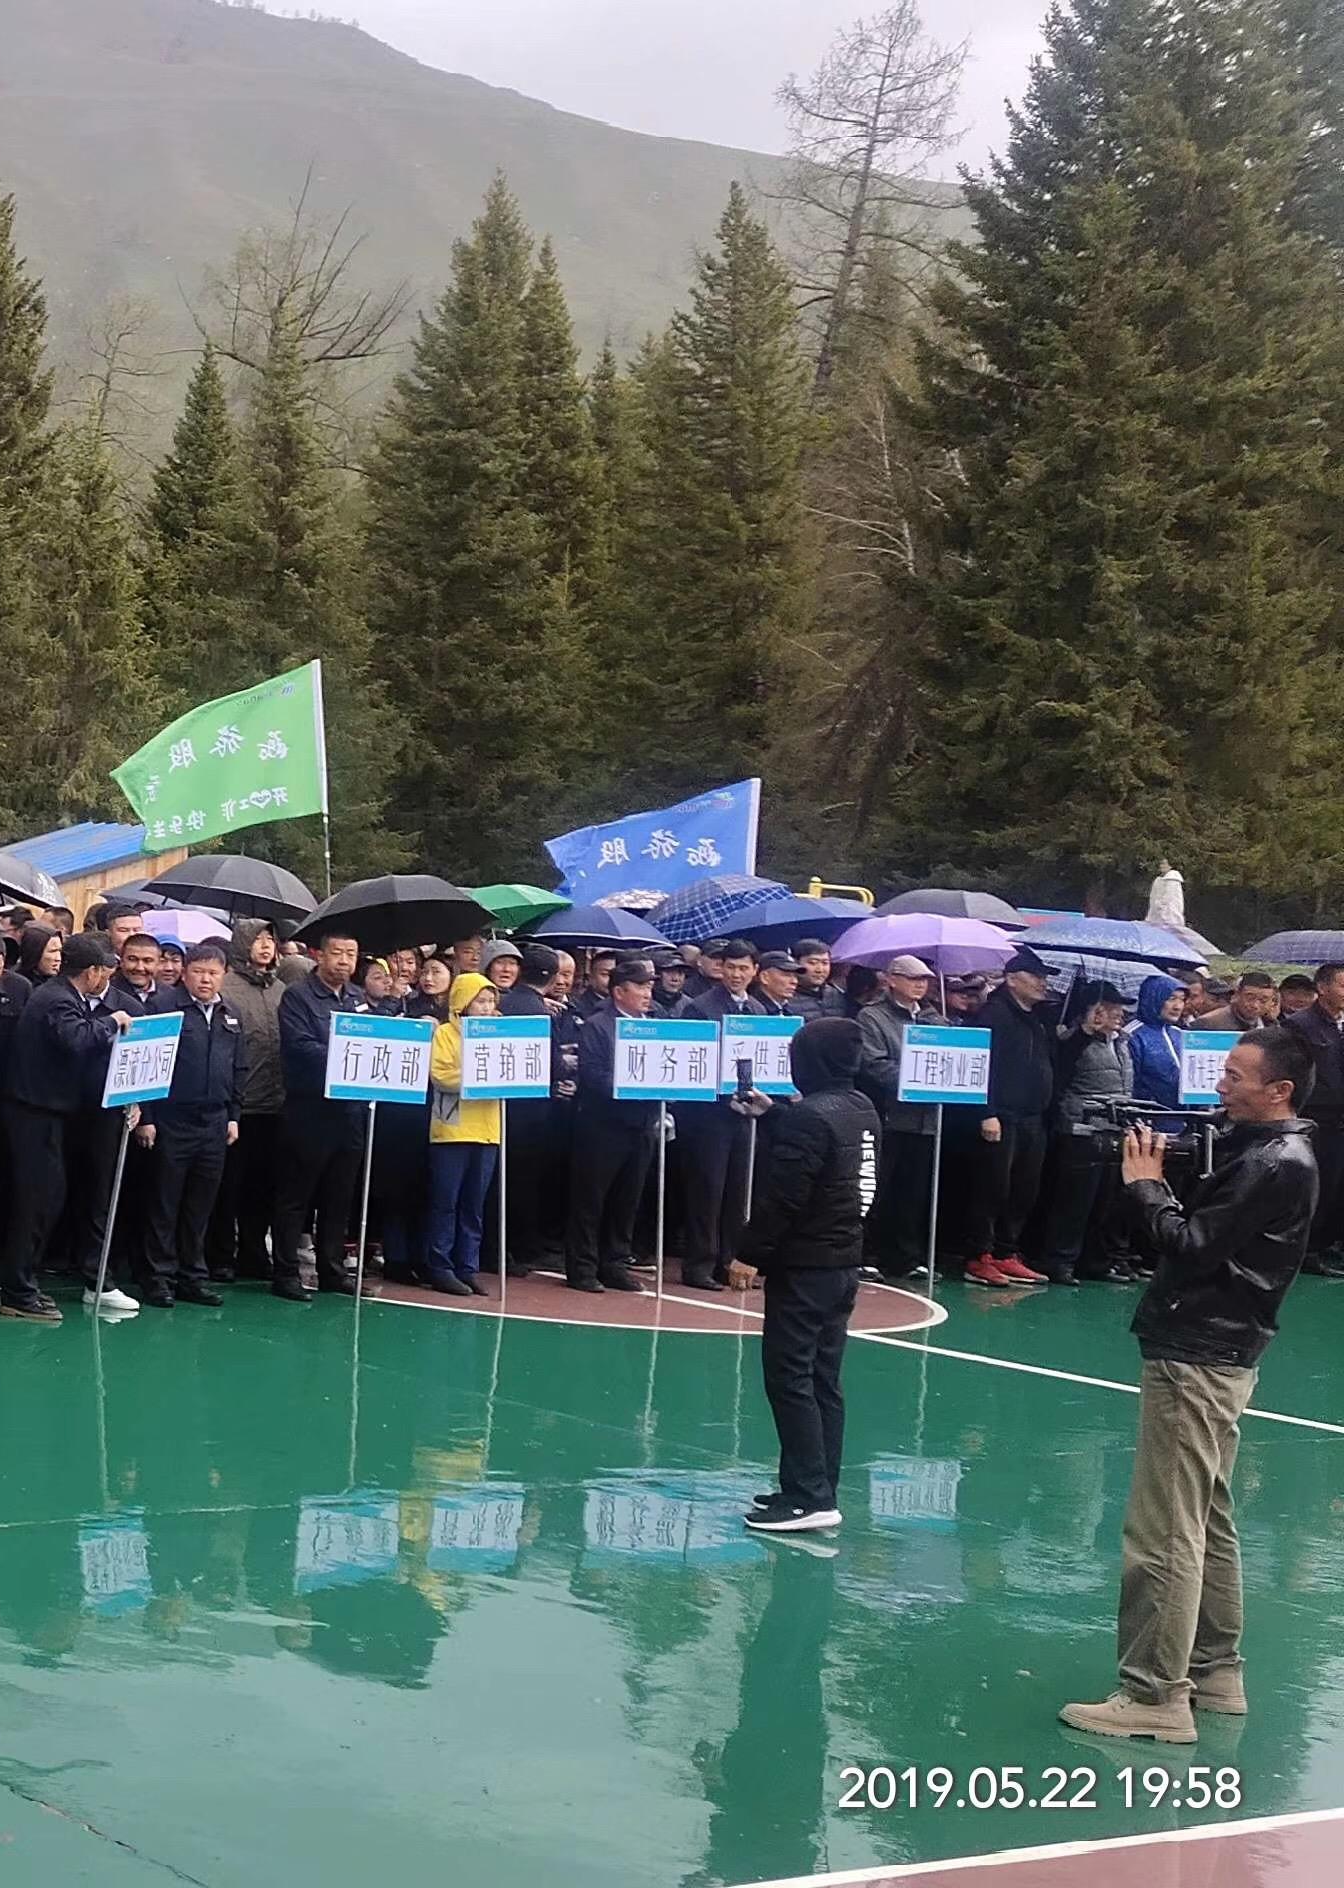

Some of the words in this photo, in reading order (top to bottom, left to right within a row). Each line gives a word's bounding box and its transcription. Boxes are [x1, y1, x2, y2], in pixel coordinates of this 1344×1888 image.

[343, 1041, 421, 1087] 行政部
[474, 1042, 543, 1083] 营销部
[627, 1044, 710, 1083] 财务部
[908, 1047, 989, 1090] 工程物业部
